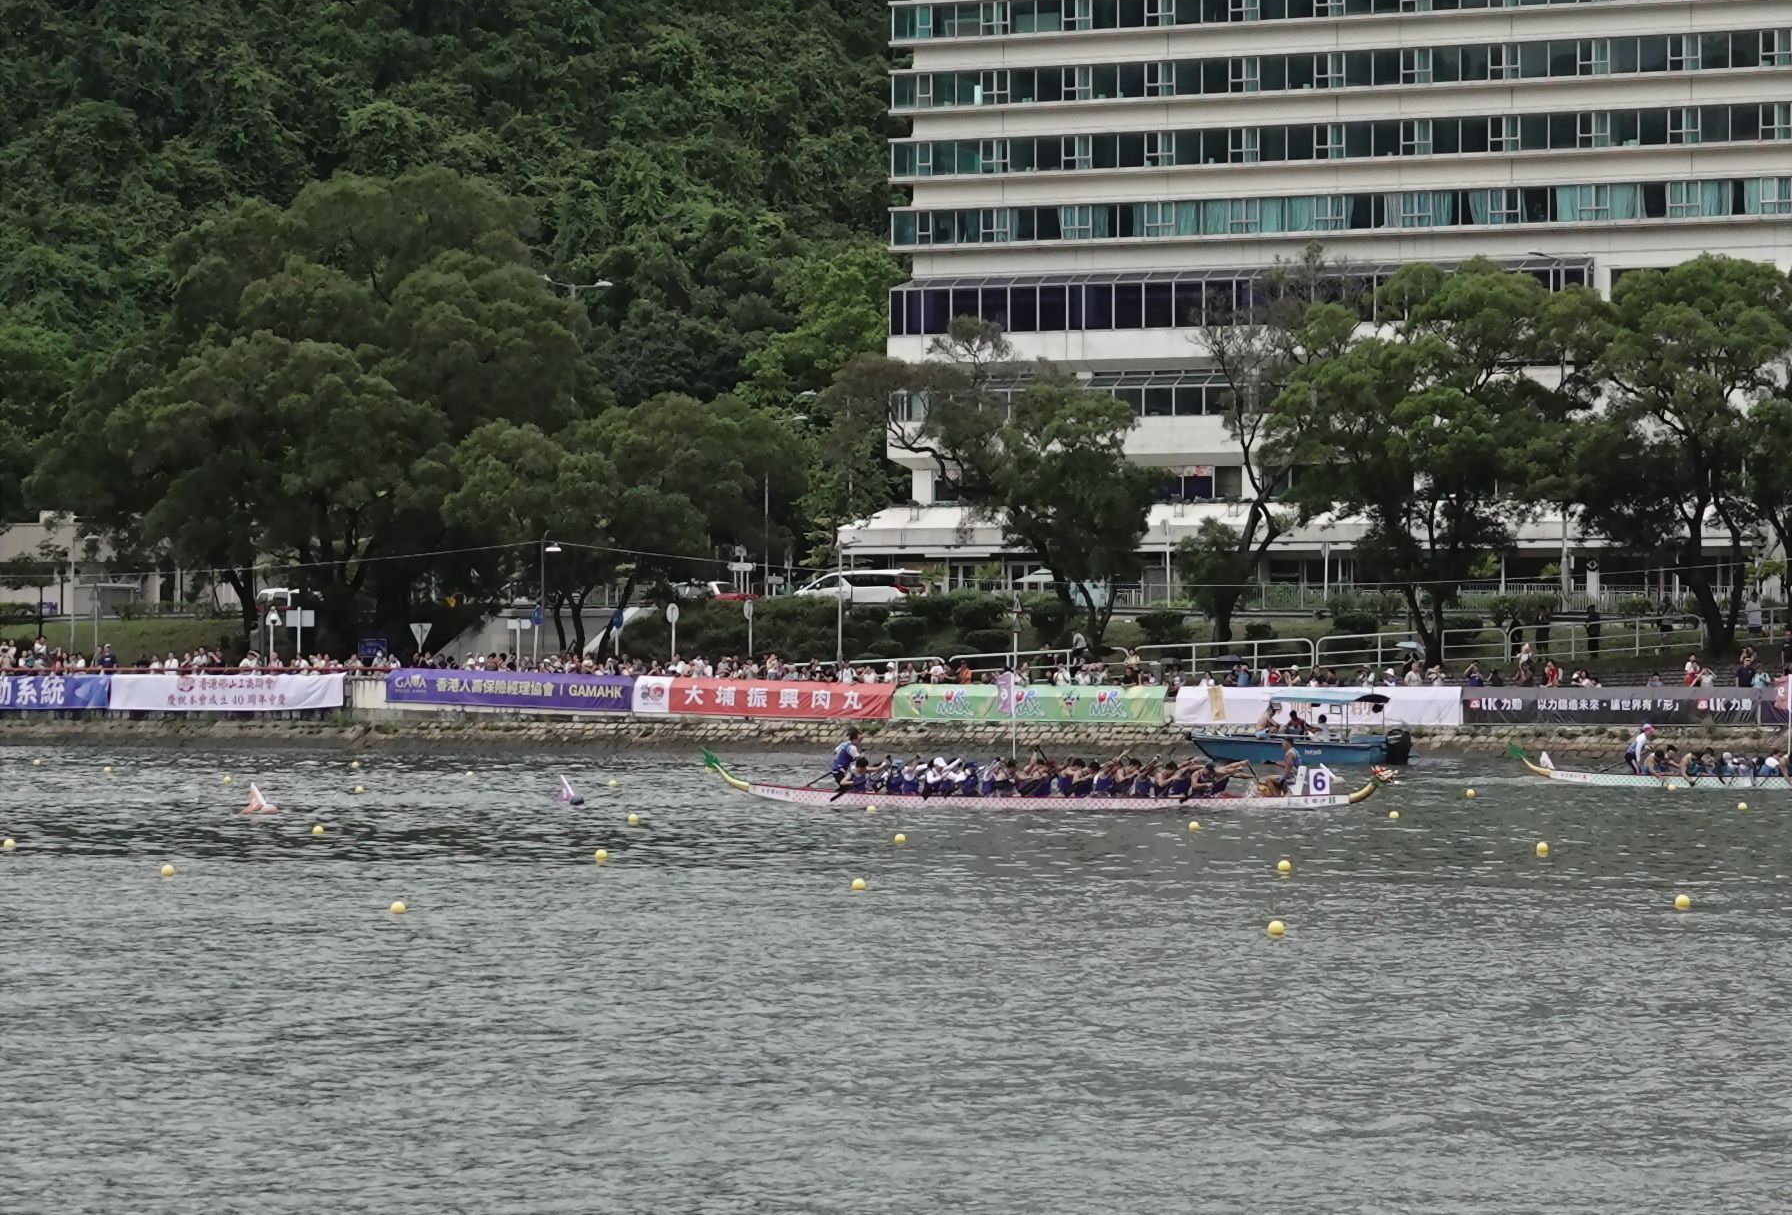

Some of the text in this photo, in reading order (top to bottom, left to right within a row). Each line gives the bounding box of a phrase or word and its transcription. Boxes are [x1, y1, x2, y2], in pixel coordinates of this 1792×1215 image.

[568, 683, 623, 699] GAMAHK
[684, 685, 862, 710] 大埔振興肉丸
[1313, 771, 1326, 791] 6
